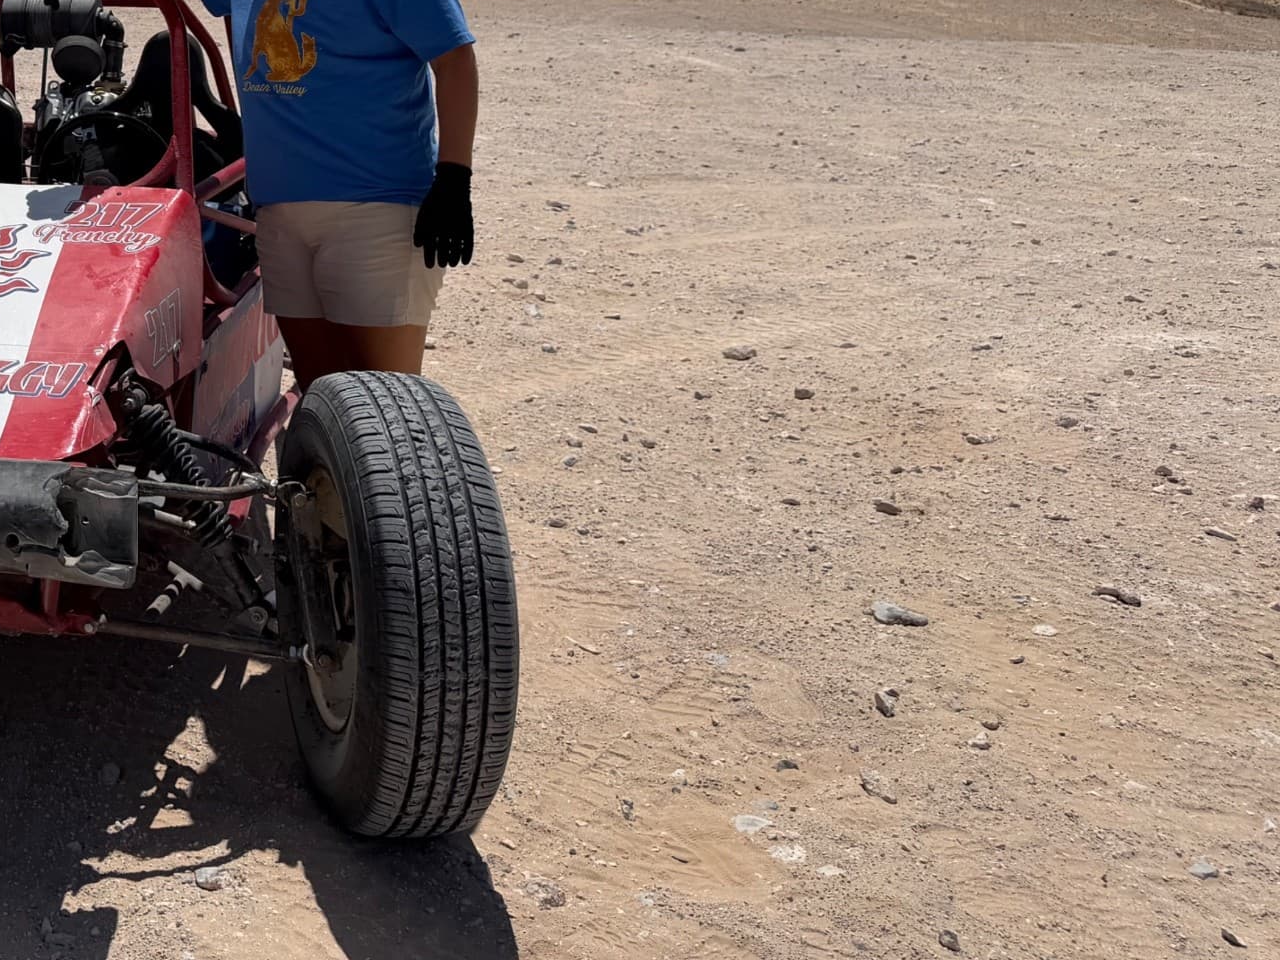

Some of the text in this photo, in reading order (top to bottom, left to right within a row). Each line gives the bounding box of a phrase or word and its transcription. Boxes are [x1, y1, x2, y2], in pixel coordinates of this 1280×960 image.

[272, 83, 308, 97] Valley
[65, 200, 166, 227] 217
[32, 223, 162, 254] Frenchy
